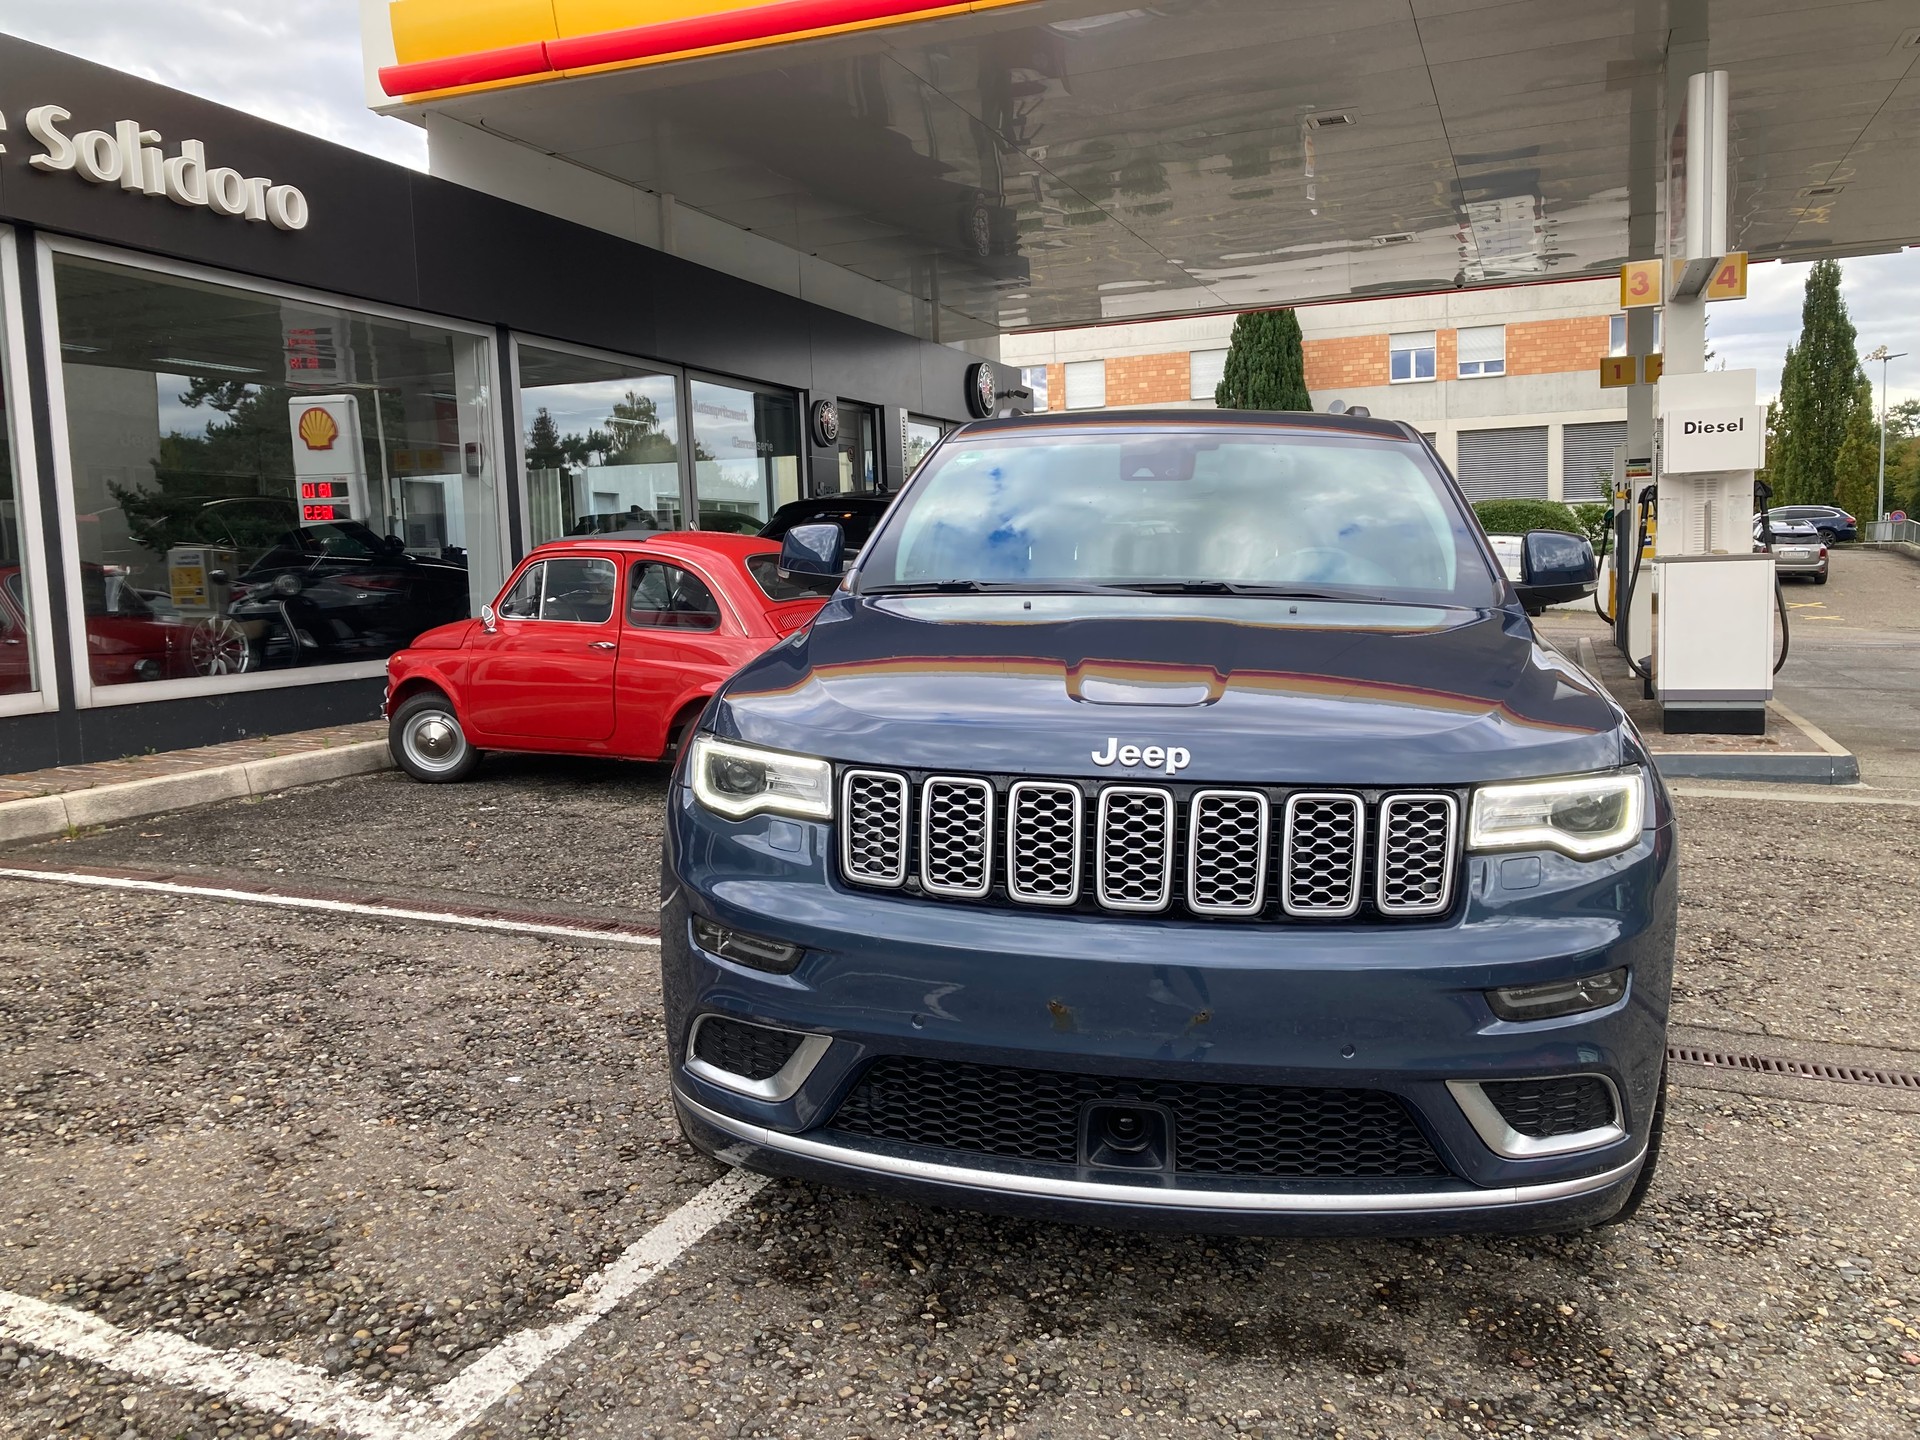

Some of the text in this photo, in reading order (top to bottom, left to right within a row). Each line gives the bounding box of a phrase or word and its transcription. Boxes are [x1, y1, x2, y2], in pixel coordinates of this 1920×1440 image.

[25, 104, 309, 230] Solidoro
[1630, 271, 1649, 296] 3
[1716, 265, 1737, 288] 4
[1613, 364, 1621, 380] 1
[1684, 417, 1744, 435] Diesel
[1091, 737, 1191, 775] Jeep
